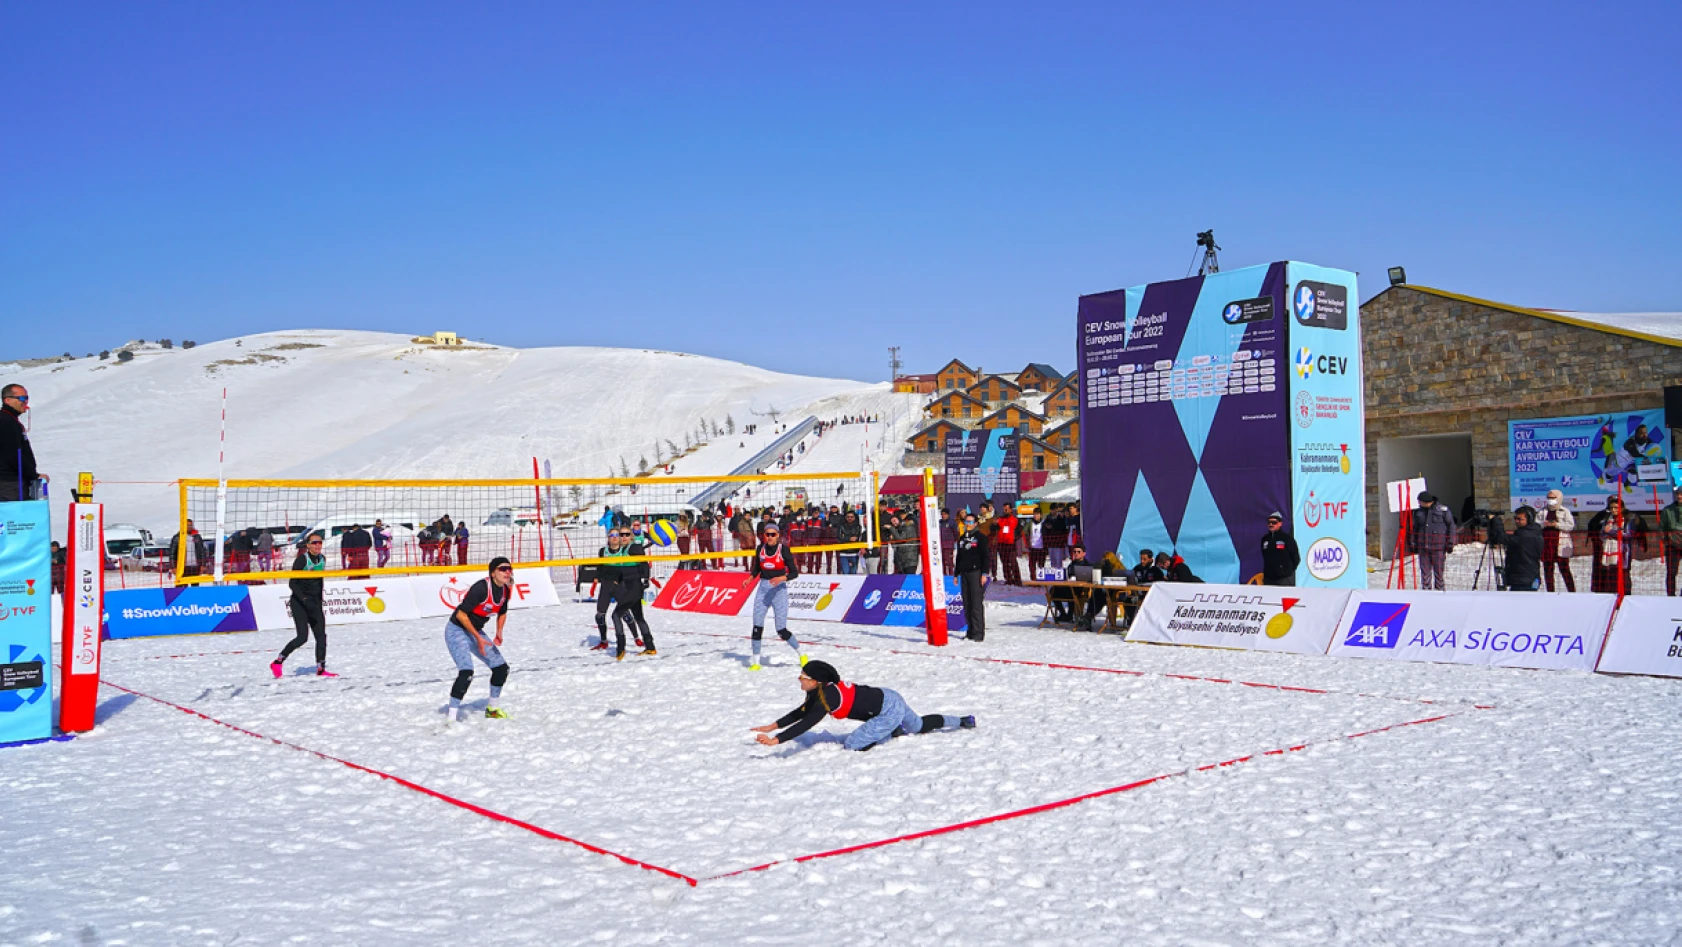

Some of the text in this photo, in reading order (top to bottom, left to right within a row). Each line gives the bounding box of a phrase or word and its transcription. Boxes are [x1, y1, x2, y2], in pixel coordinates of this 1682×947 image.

[1085, 312, 1168, 333] CEV Snow Volleyball
[1085, 326, 1163, 345] European Tour 2022
[1317, 355, 1348, 375] CEV
[1515, 430, 1532, 440] CEV
[1516, 438, 1589, 450] KAR VOLEYBOLU
[1300, 453, 1339, 465] Kahramanmaraş
[1516, 450, 1577, 462] AVRUPA TURU
[1516, 463, 1536, 472] 2022
[1323, 502, 1348, 520] TVF
[1313, 546, 1343, 564] MADO
[83, 569, 92, 592] CEV
[698, 586, 738, 606] TVF
[892, 590, 910, 599] CEV
[11, 606, 36, 616] TVF
[122, 602, 240, 619] #SnowVolleyball
[329, 607, 366, 616] Belediyesi
[885, 602, 922, 613] European
[1173, 605, 1266, 623] Kahramanmaraş
[83, 626, 93, 647] TVF
[1167, 620, 1261, 637] Büyükşehir Belediyesi
[1344, 624, 1388, 645] AXA
[1408, 627, 1584, 655] AXA SİGORTA
